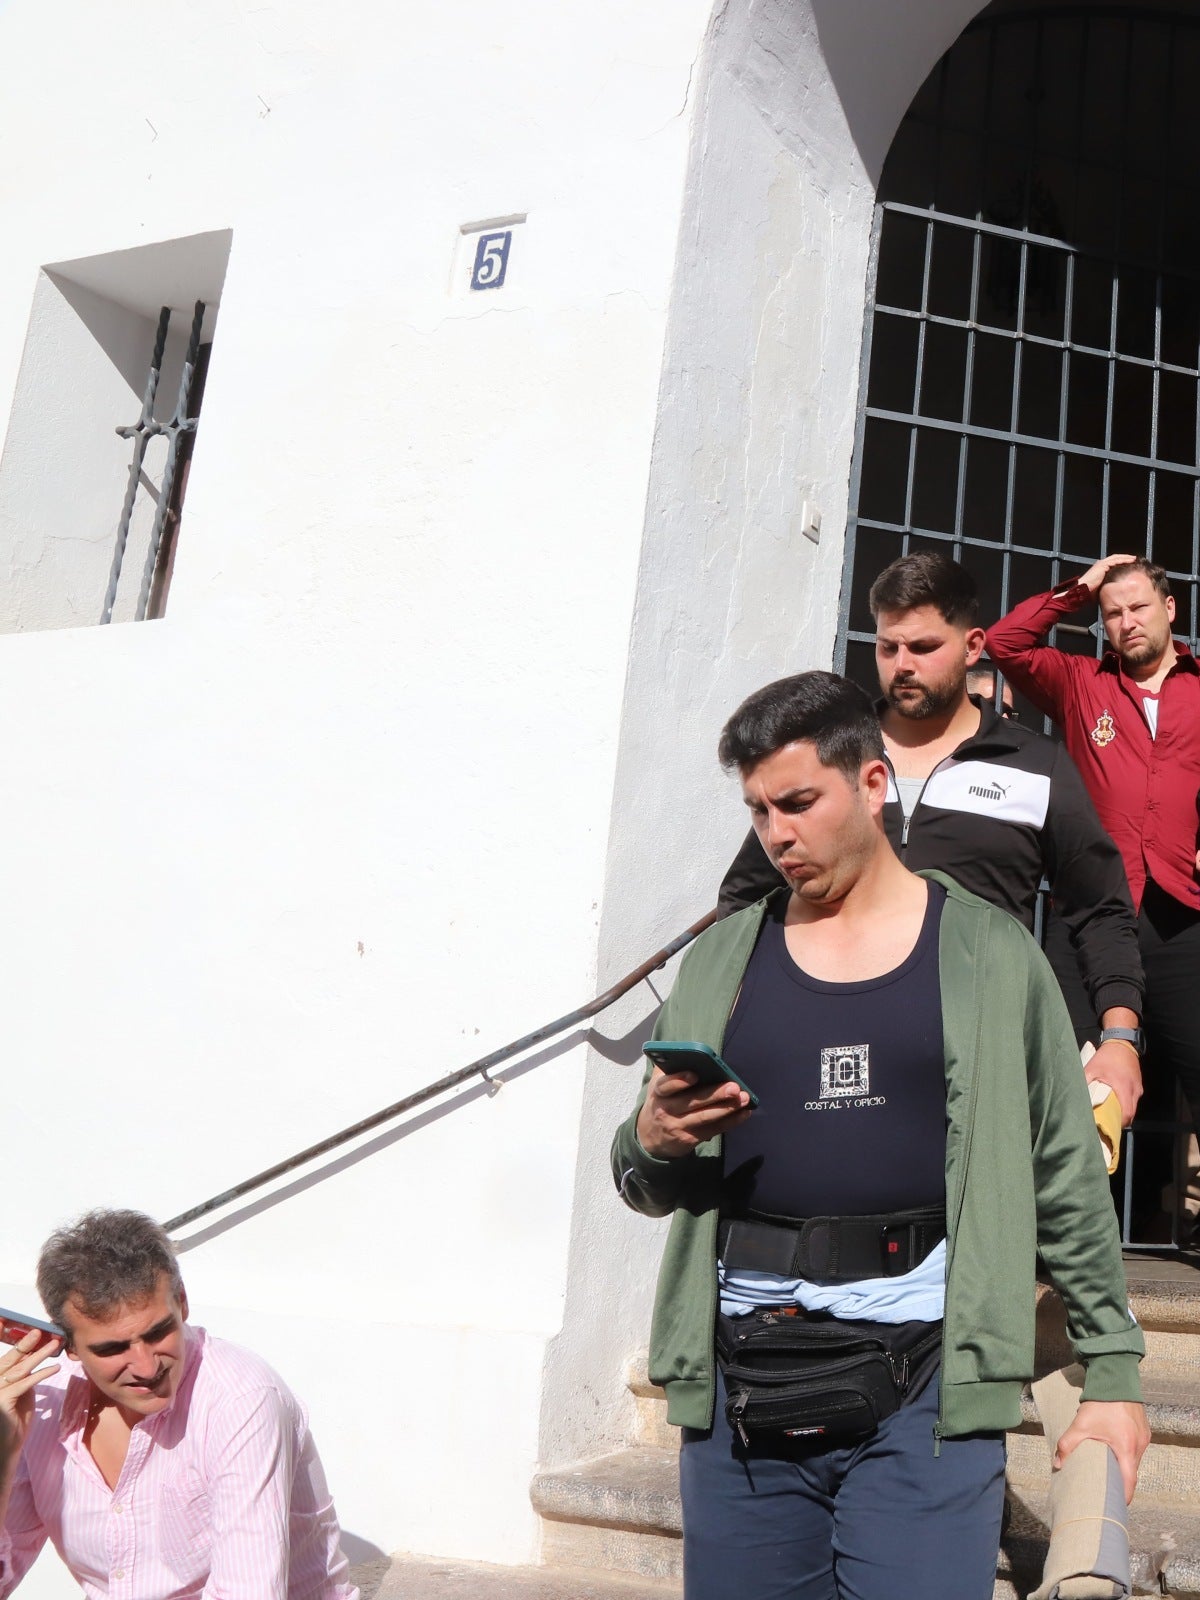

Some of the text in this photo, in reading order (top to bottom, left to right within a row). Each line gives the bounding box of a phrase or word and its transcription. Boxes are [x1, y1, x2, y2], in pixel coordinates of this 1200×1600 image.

[477, 238, 505, 285] 5
[968, 785, 1001, 800] PUMA
[804, 1096, 886, 1111] COSTAL Y OFICIO
